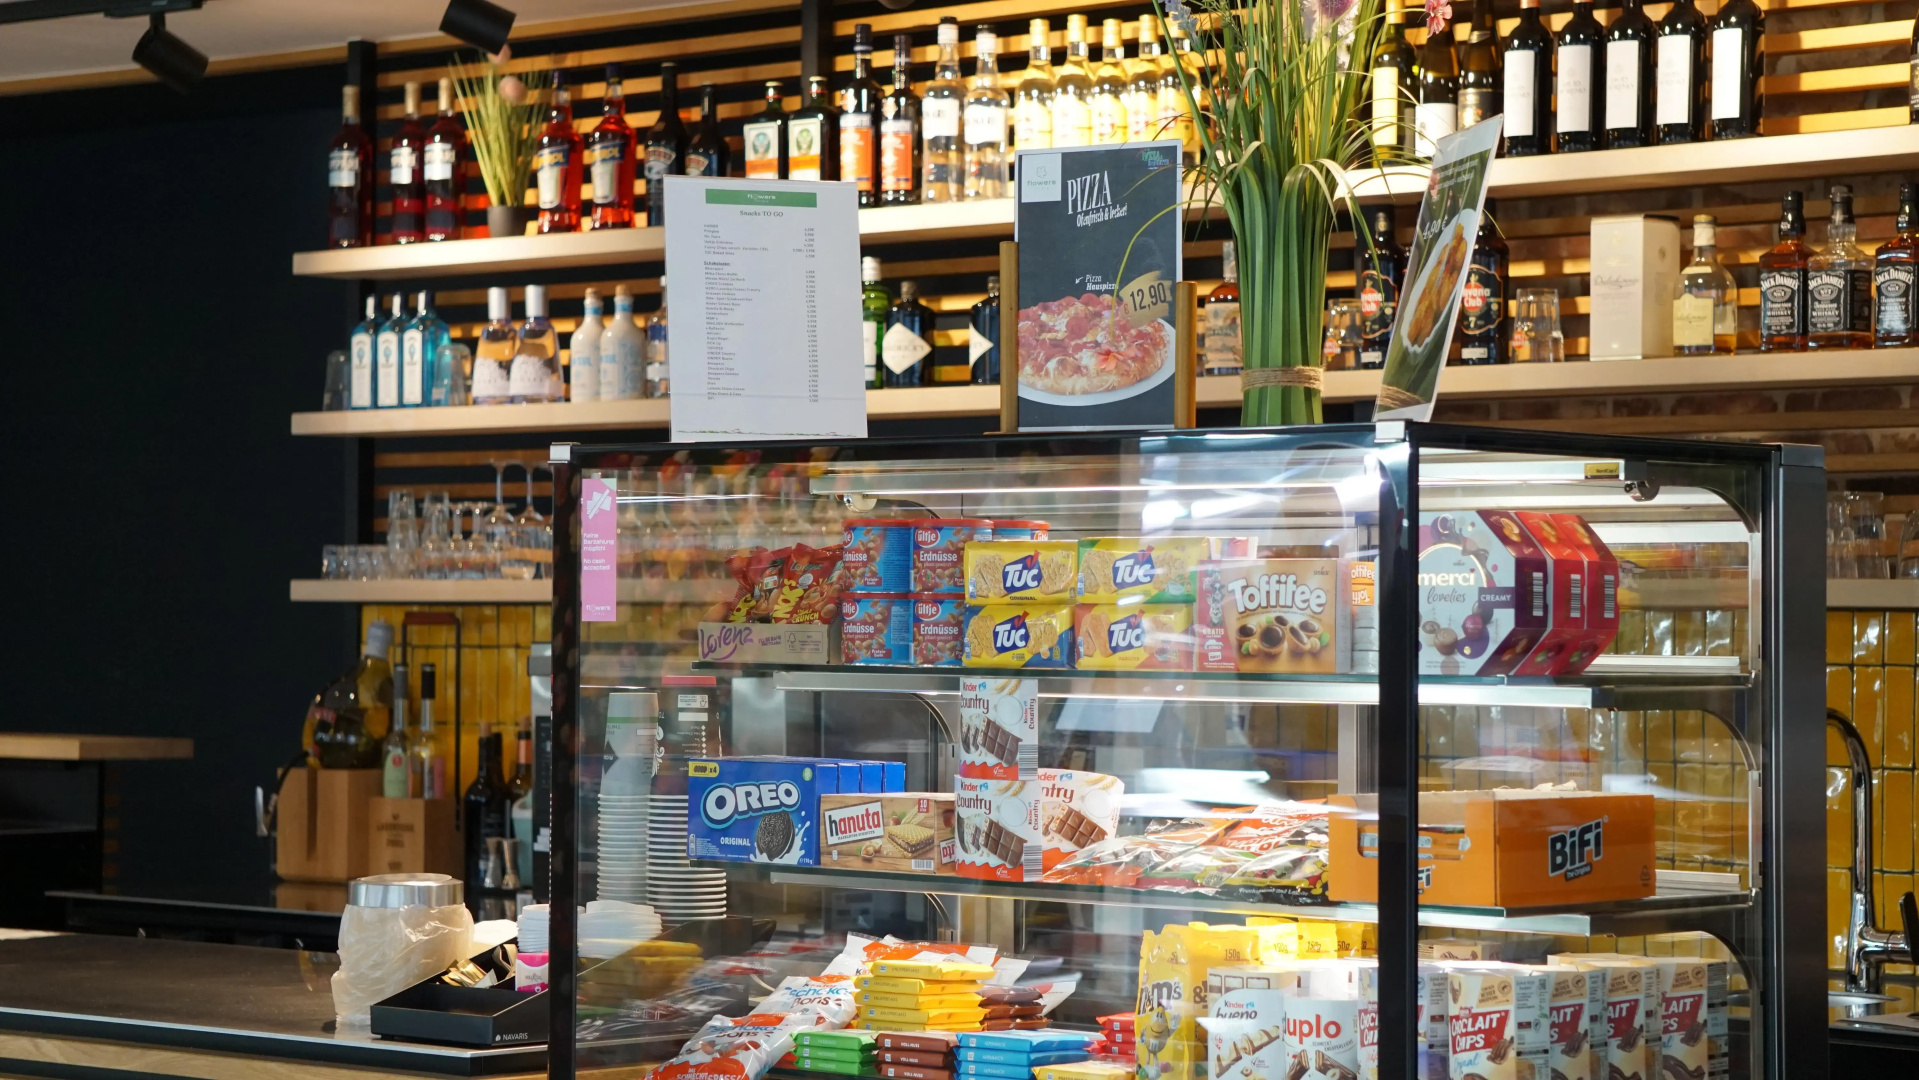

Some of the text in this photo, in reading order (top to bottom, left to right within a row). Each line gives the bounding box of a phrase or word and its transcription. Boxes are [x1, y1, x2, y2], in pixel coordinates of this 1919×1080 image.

[1066, 170, 1112, 215] PIZZA
[1085, 274, 1102, 283] Pizza
[1760, 278, 1776, 292] JACK
[1808, 278, 1823, 291] JACK
[1876, 272, 1891, 286] JACK
[1129, 282, 1167, 313] 12,90
[1464, 296, 1483, 308] Club
[917, 529, 937, 543] ültje
[919, 551, 958, 562] Erdnüsse
[1005, 563, 1039, 588] TUC
[1114, 558, 1152, 583] TUC
[1351, 565, 1375, 580] offifee
[1418, 568, 1475, 586] merci
[1227, 573, 1327, 615] Toffifee
[1427, 586, 1466, 605] lovelies
[1480, 594, 1511, 602] CREAMY
[917, 602, 938, 617] ültje
[791, 611, 819, 624] CRUNCH
[843, 622, 875, 633] Erdnüsse
[920, 623, 959, 635] Erdnüsse
[995, 623, 1026, 647] TUC
[1109, 623, 1142, 647] TUC
[700, 625, 754, 660] Lorenz
[1028, 698, 1036, 730] Country
[709, 765, 717, 774] x4
[1042, 783, 1075, 804] ntry
[705, 782, 799, 821] OREO
[919, 799, 928, 808] 10
[956, 793, 992, 815] Country
[828, 807, 881, 837] hanuta
[720, 837, 751, 847] ORIGINAL
[1549, 819, 1602, 876] BiFi
[1337, 940, 1351, 950] 50g
[1224, 948, 1241, 960] 150g
[502, 1032, 529, 1041] NAVARIS
